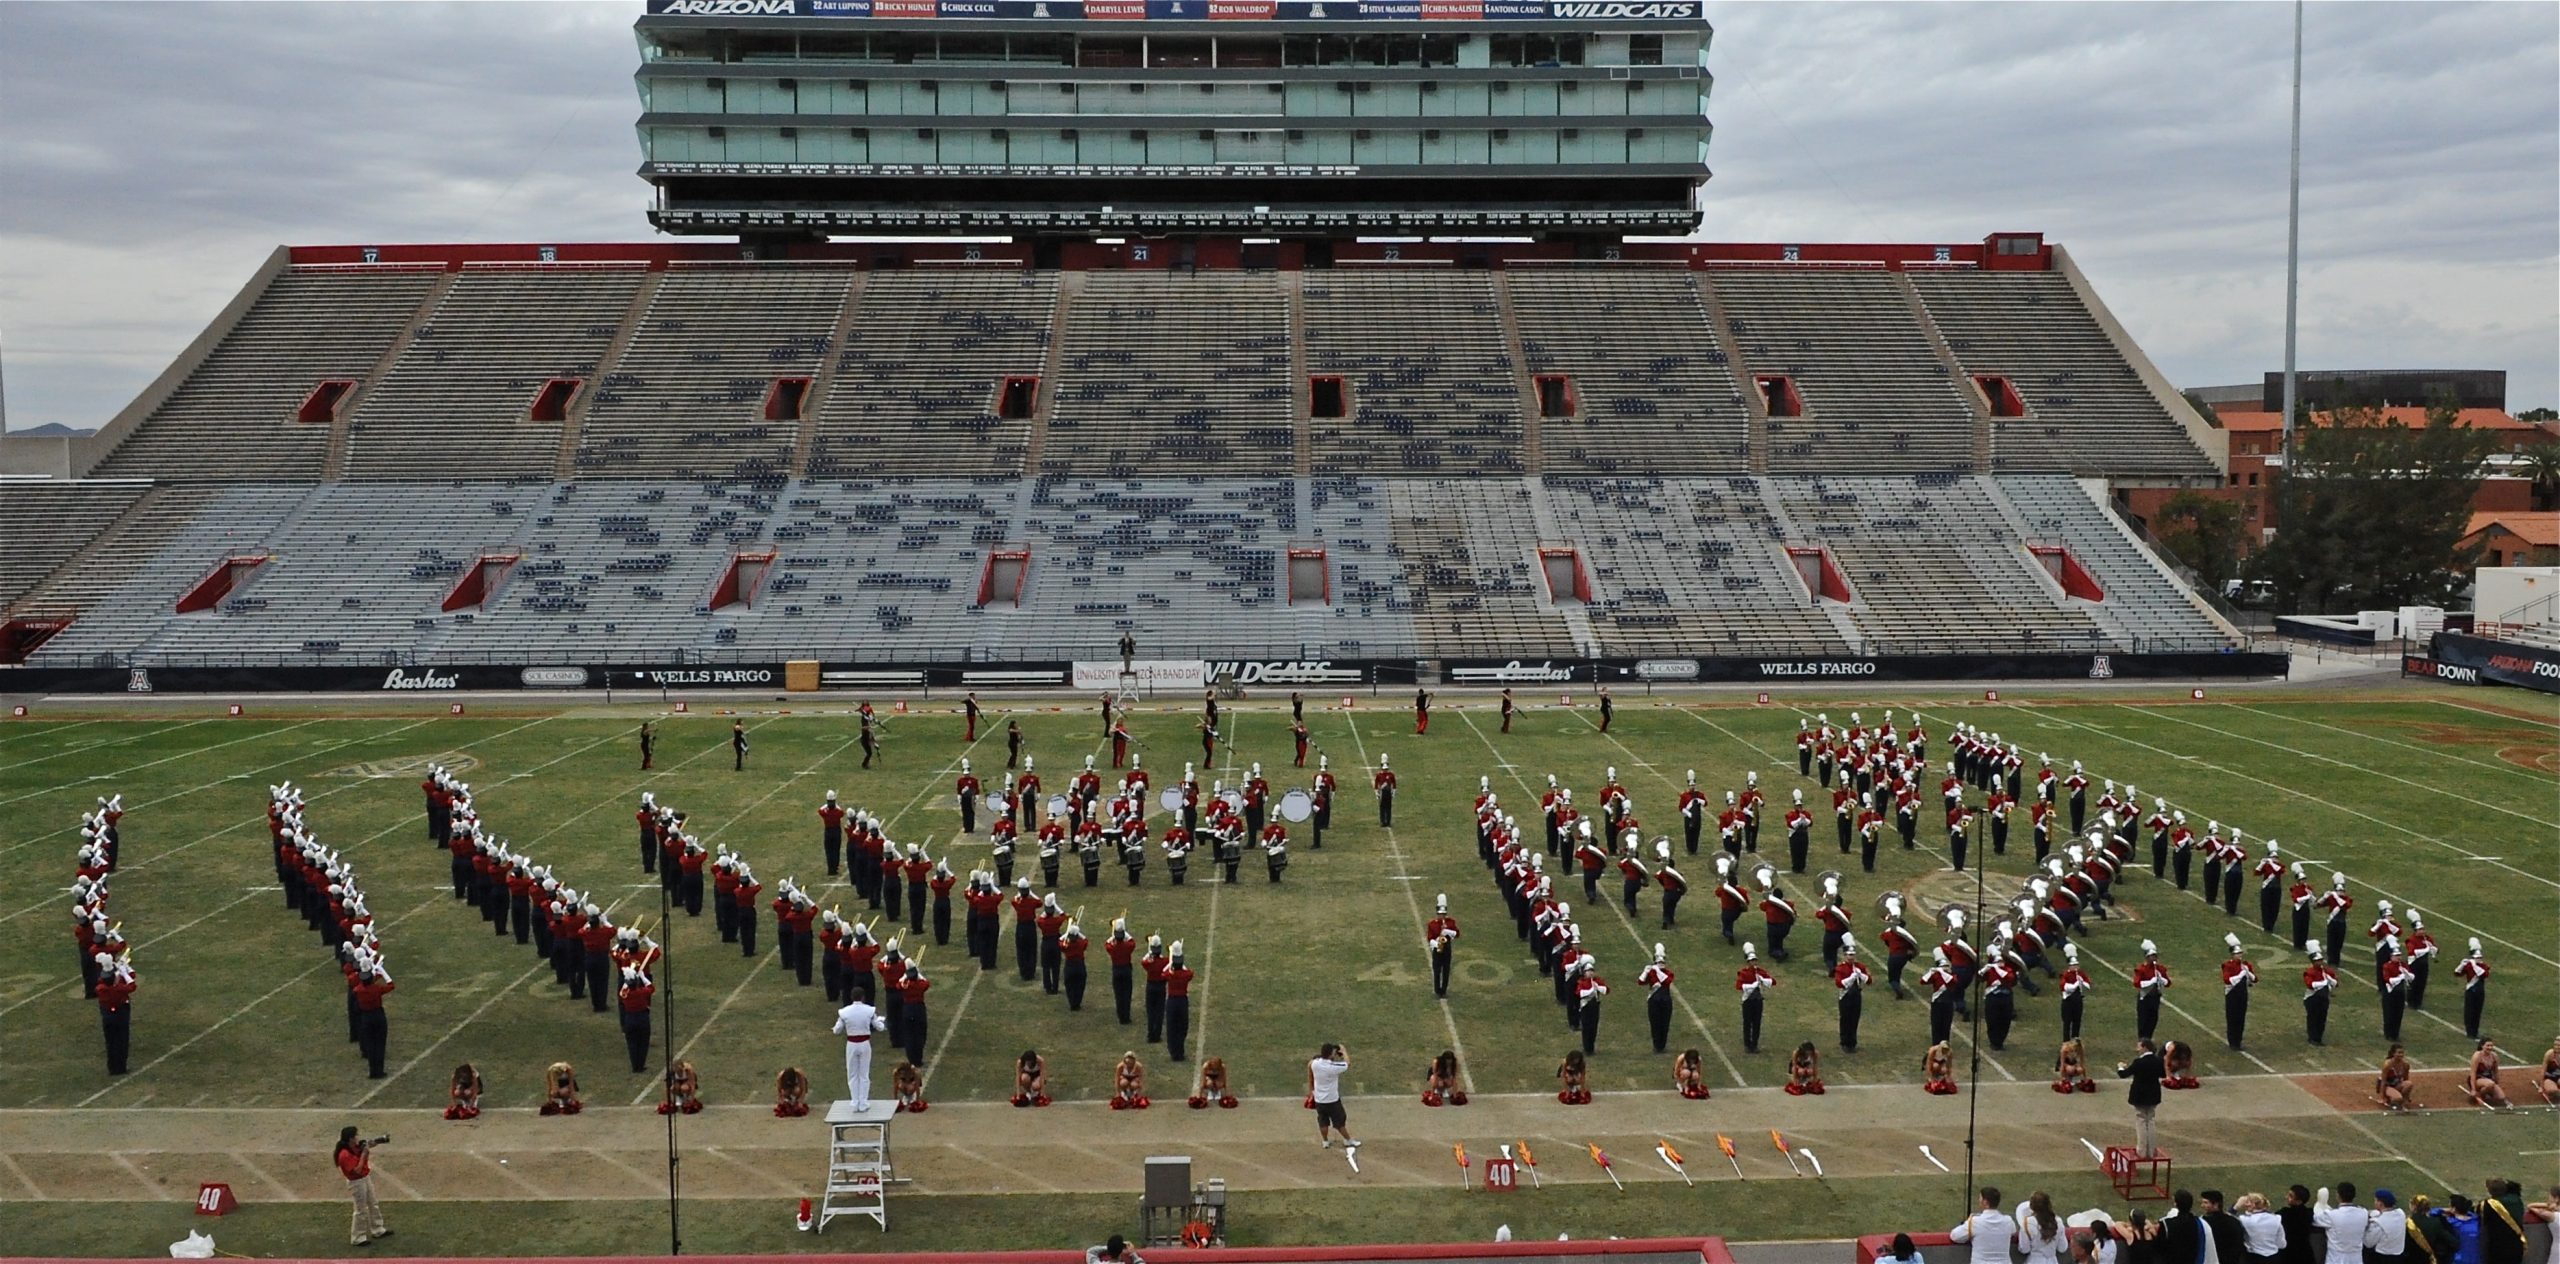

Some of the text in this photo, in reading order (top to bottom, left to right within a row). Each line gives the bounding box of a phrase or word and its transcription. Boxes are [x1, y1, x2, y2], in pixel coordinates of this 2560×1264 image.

[662, 0, 796, 14] ARIZONA
[813, 1, 870, 10] 22 ART LUPPINO
[884, 3, 906, 11] RICKY
[907, 3, 935, 11] HUNLEY
[947, 3, 974, 12] CHUCK
[974, 4, 995, 12] CECIL
[1084, 5, 1089, 13] 4
[1123, 6, 1145, 14] LEWIS
[1218, 5, 1234, 13] ROB
[1235, 5, 1270, 13] WALDROP
[1368, 5, 1384, 13] STEVE
[1428, 5, 1448, 13] CHRIS
[1449, 5, 1483, 13] McALISTER
[1553, 3, 1693, 18] WILDCATS
[365, 253, 377, 262] 17
[541, 251, 554, 261] 18
[742, 251, 754, 261] 19
[966, 250, 980, 260] 20
[1134, 250, 1147, 260] 21
[1385, 250, 1399, 260] 22
[1606, 250, 1620, 260] 23
[1784, 251, 1798, 261] 24
[1936, 252, 1949, 262] 25
[1760, 663, 1876, 675] WELLS FARGO
[2438, 664, 2477, 682] DOWN
[382, 668, 460, 689] Bashas'
[650, 670, 771, 683] WELLS FARGO
[1076, 669, 1116, 680] UNIVERSITY
[1163, 669, 1184, 680] BAND
[1186, 669, 1200, 679] DAY
[1490, 1164, 1511, 1186] 40
[199, 1187, 221, 1211] 40
